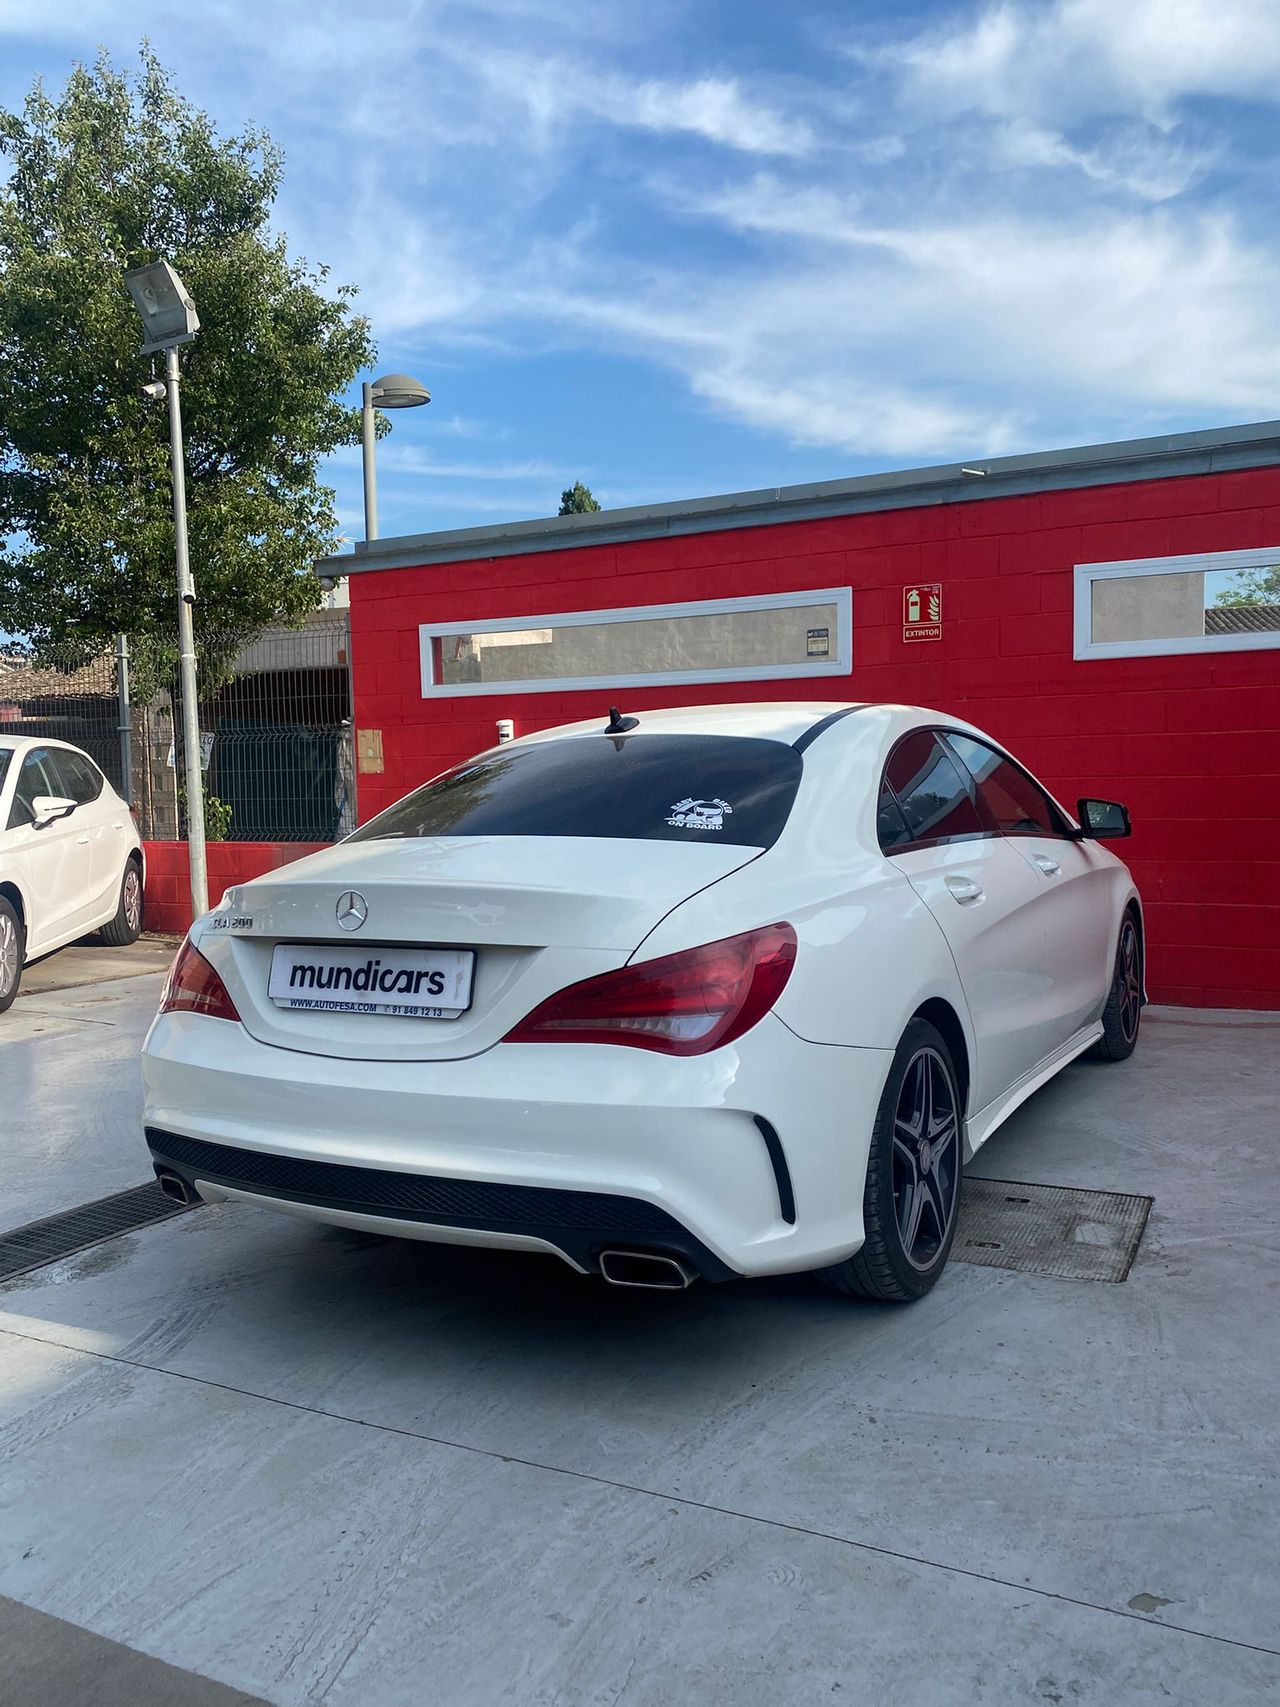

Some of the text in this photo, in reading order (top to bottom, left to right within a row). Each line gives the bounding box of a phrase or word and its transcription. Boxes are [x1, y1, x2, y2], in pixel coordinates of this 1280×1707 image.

[905, 628, 939, 637] EXTINTOR
[289, 959, 446, 996] mundicars
[289, 998, 443, 1017] WWW.AUTOFESA.COM 91 849 12 13
